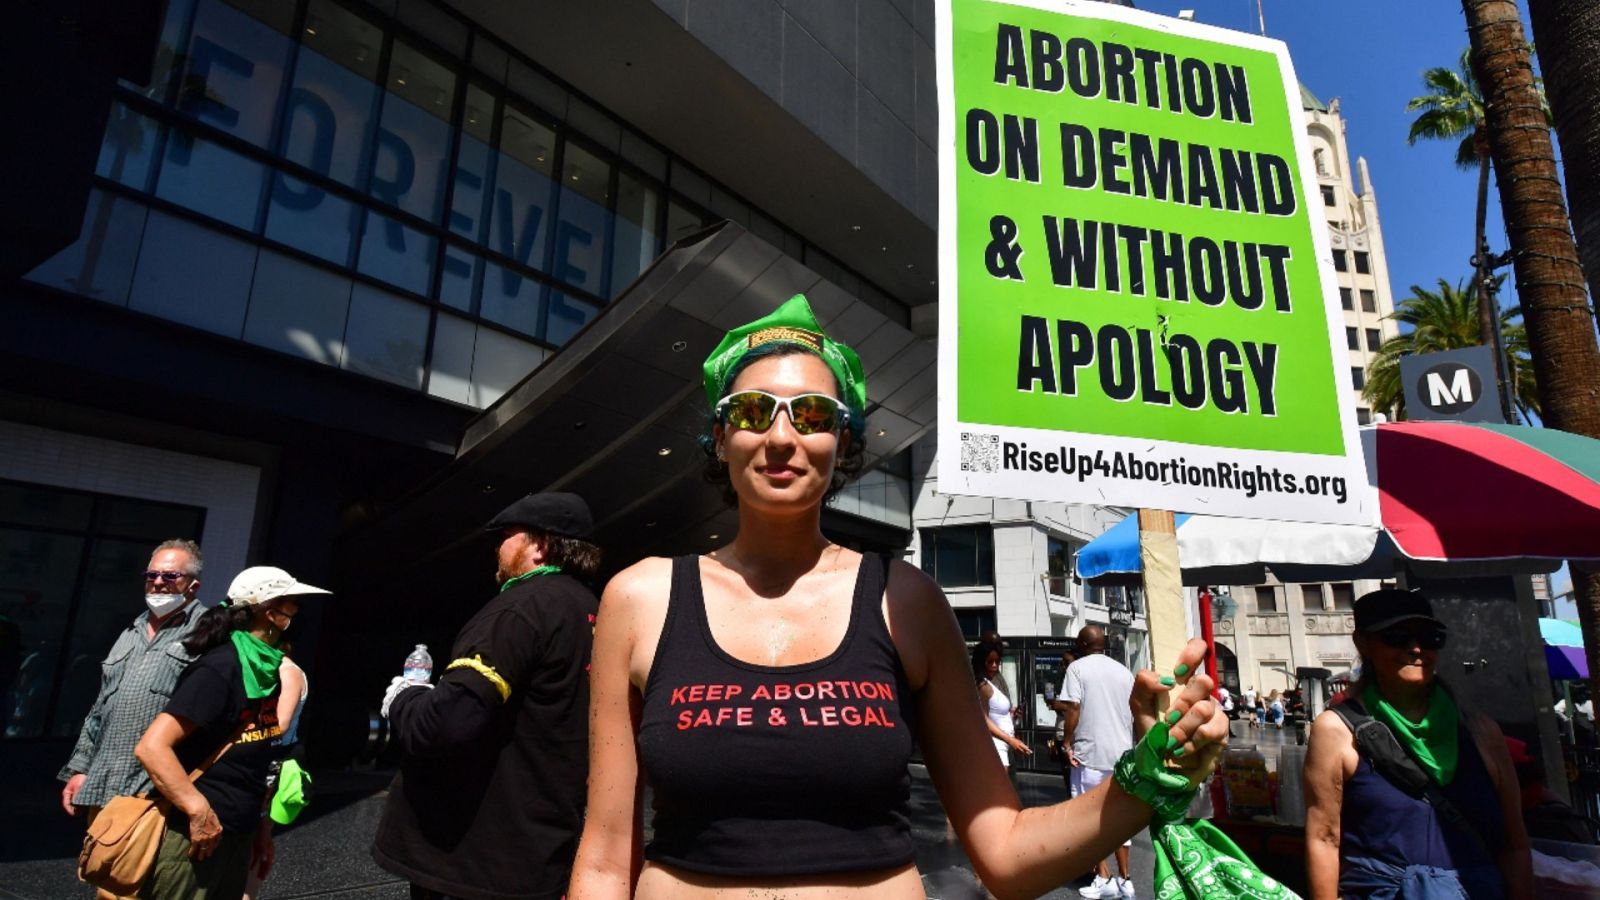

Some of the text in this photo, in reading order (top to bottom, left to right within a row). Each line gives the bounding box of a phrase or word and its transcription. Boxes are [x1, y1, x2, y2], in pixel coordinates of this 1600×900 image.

[993, 22, 1252, 124] ABORTION
[966, 107, 1297, 217] ON DEMAND
[984, 214, 1292, 313] & WITHOUT
[1016, 314, 1279, 417] APOLOGY
[1427, 369, 1473, 406] M
[1003, 442, 1347, 503] RiseUp4AbortionRights.org
[671, 681, 894, 705] KEEP ABORTION
[677, 706, 895, 729] SAFE & LEGAL
